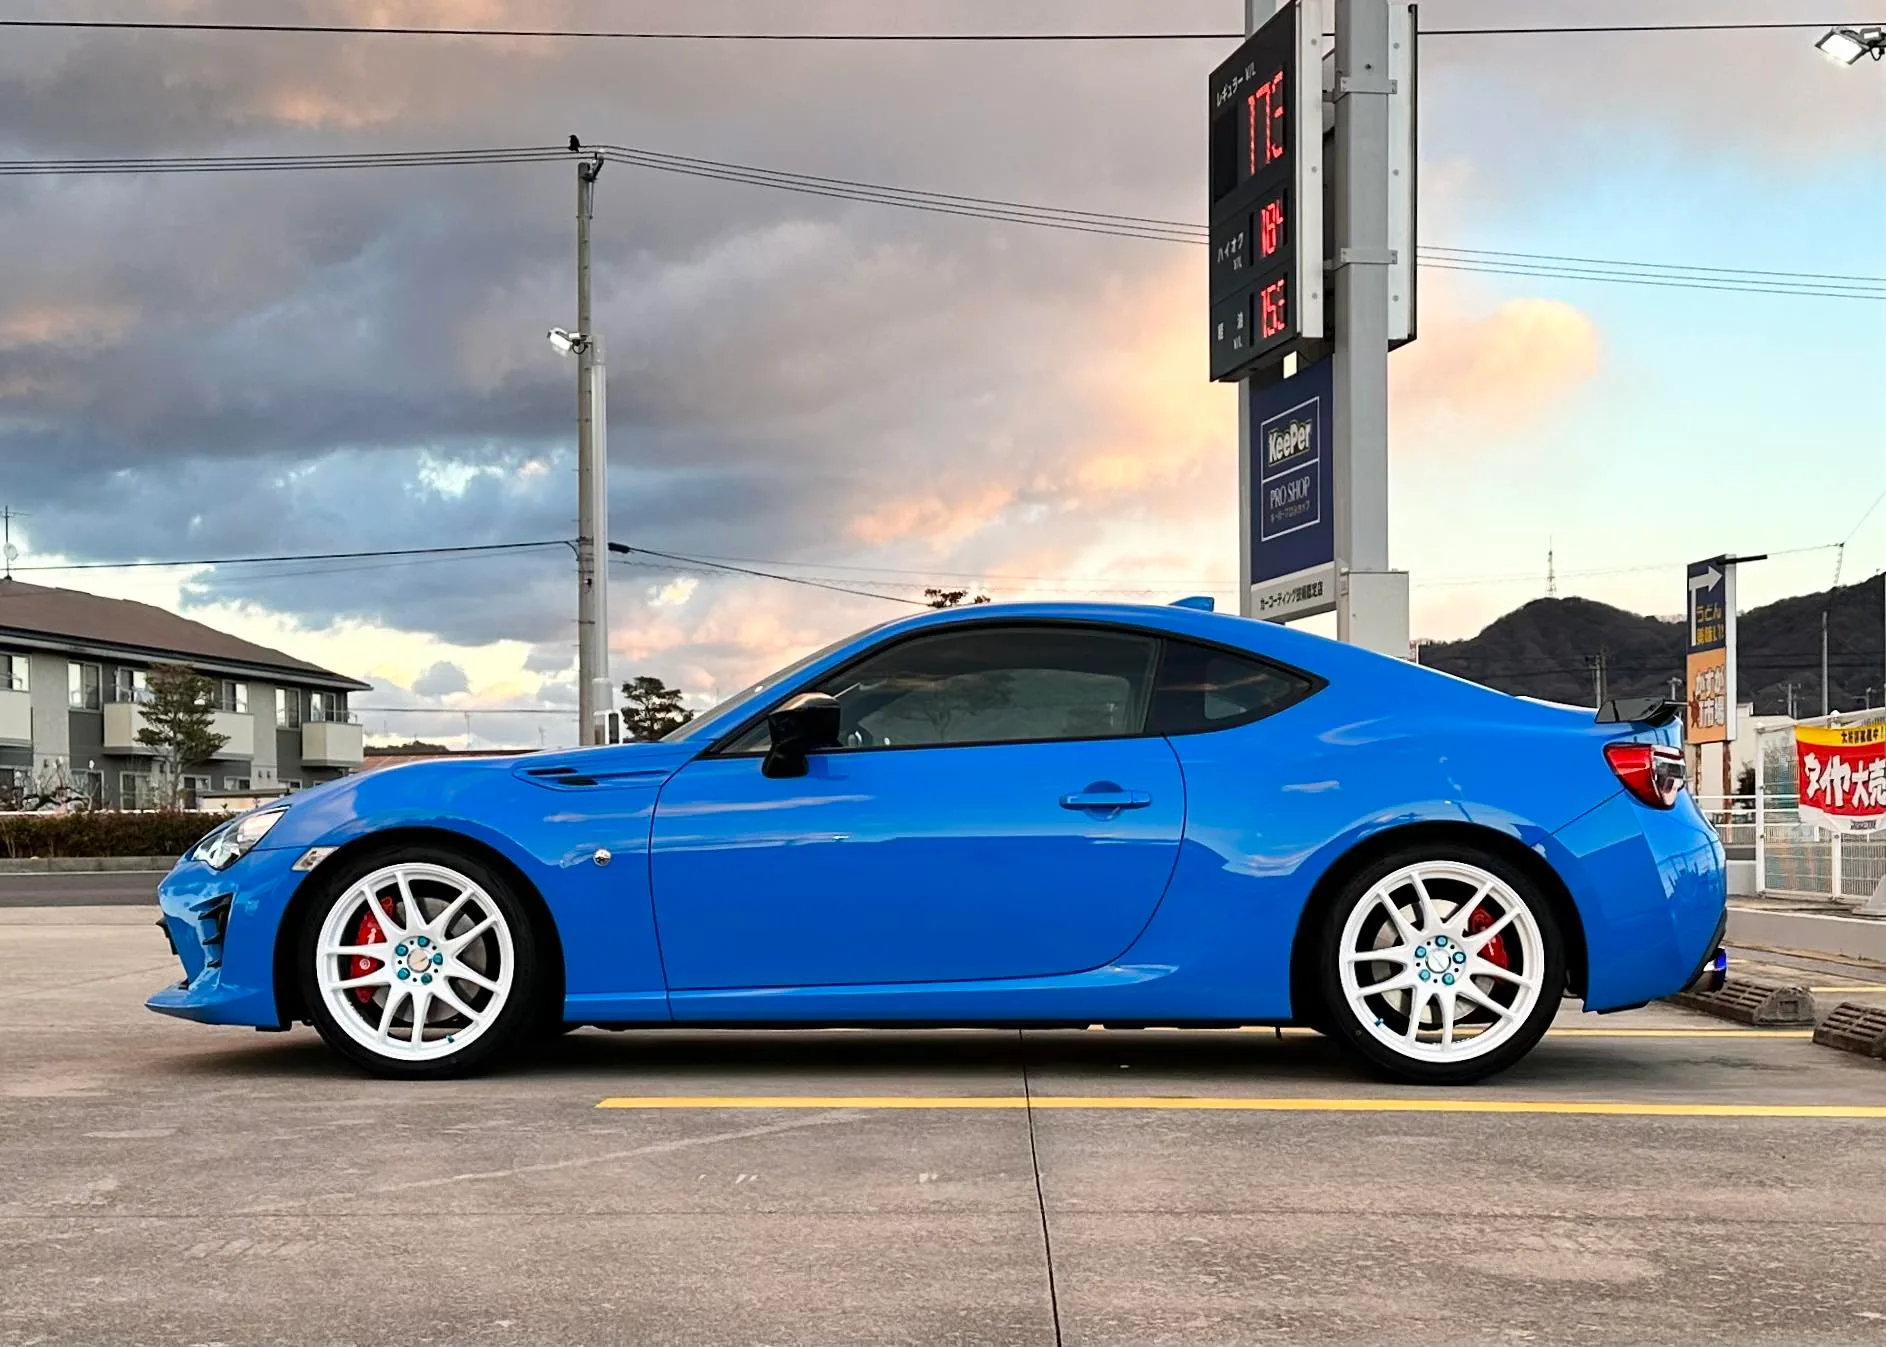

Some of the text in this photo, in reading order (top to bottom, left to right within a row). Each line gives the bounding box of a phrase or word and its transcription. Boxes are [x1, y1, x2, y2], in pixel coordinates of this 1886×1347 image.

[1216, 76, 1244, 107] レギュラー
[1217, 231, 1244, 264] ハイオク
[1268, 420, 1312, 466] KeePer
[1270, 476, 1311, 510] PRO SHOP
[1696, 602, 1722, 623] うどん
